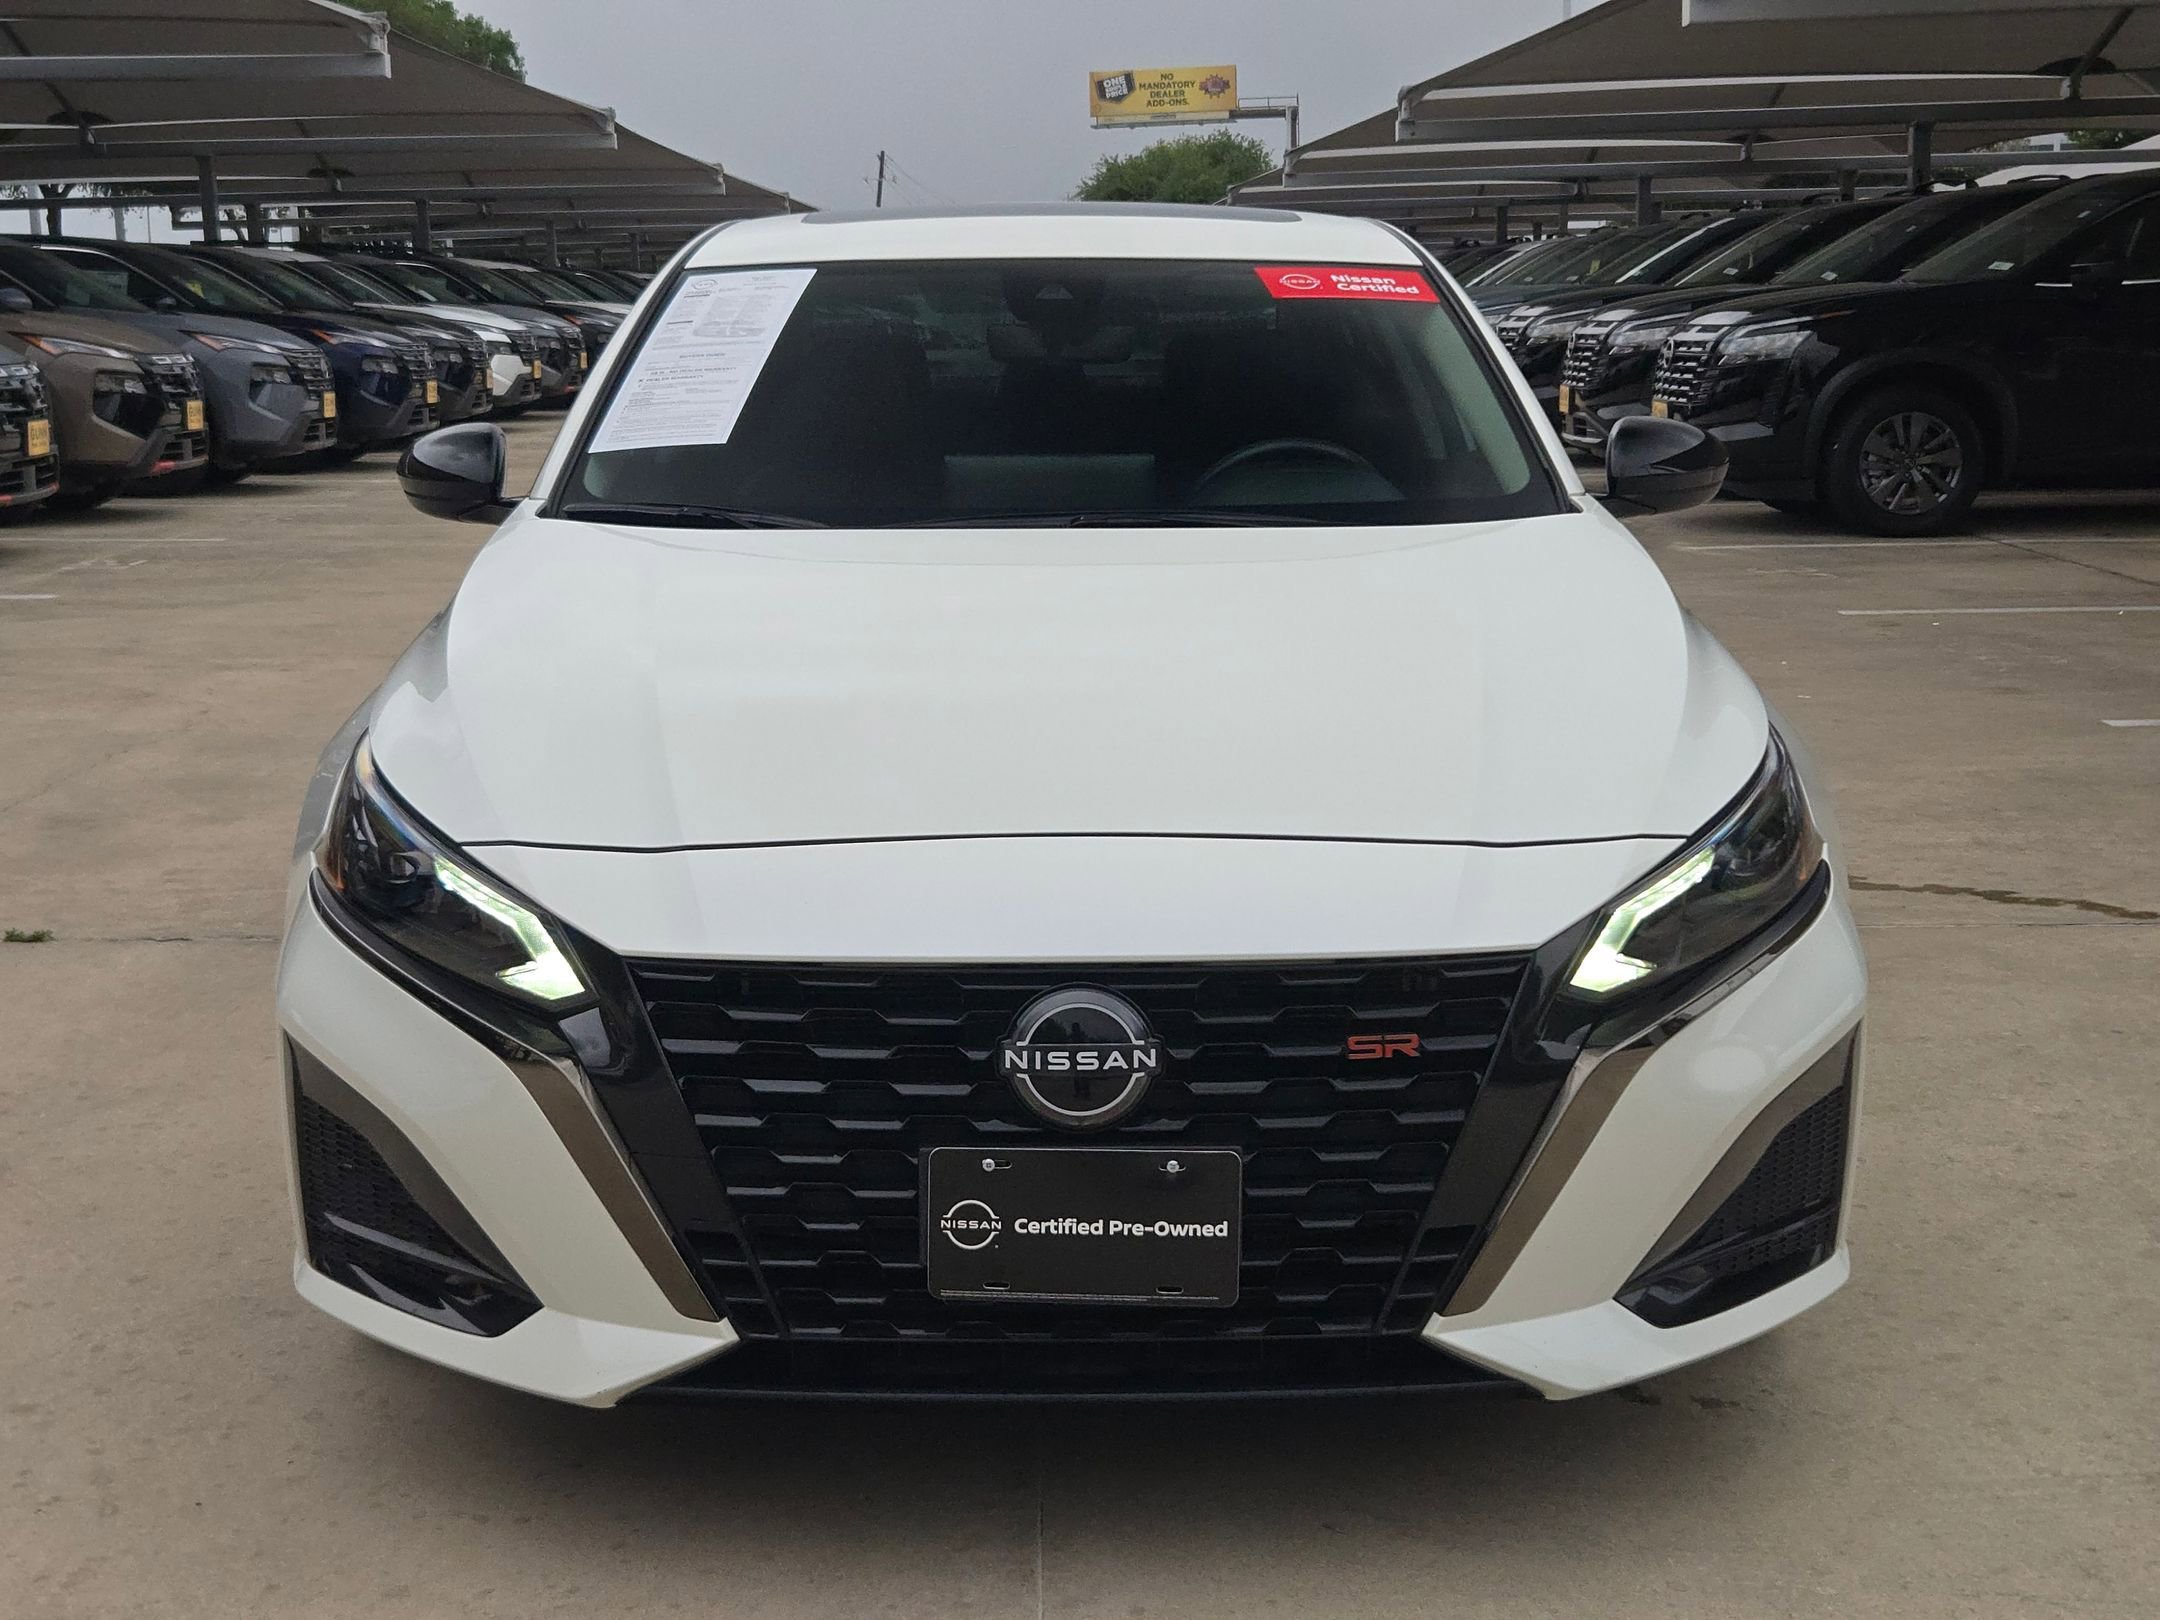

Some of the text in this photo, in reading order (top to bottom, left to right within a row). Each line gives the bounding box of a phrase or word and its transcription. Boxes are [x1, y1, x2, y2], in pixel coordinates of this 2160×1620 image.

[1103, 75, 1126, 88] ONE
[1160, 73, 1174, 81] NO
[1139, 81, 1196, 91] MANDATORY
[1150, 90, 1185, 98] DEALER
[1330, 274, 1396, 285] Nissan
[1337, 283, 1420, 294] Certified
[1347, 1033, 1421, 1059] SR
[1005, 1049, 1156, 1071] NISSAN
[941, 1219, 1002, 1230] NISSAN
[1014, 1218, 1228, 1237] Certified Pre-Owned
